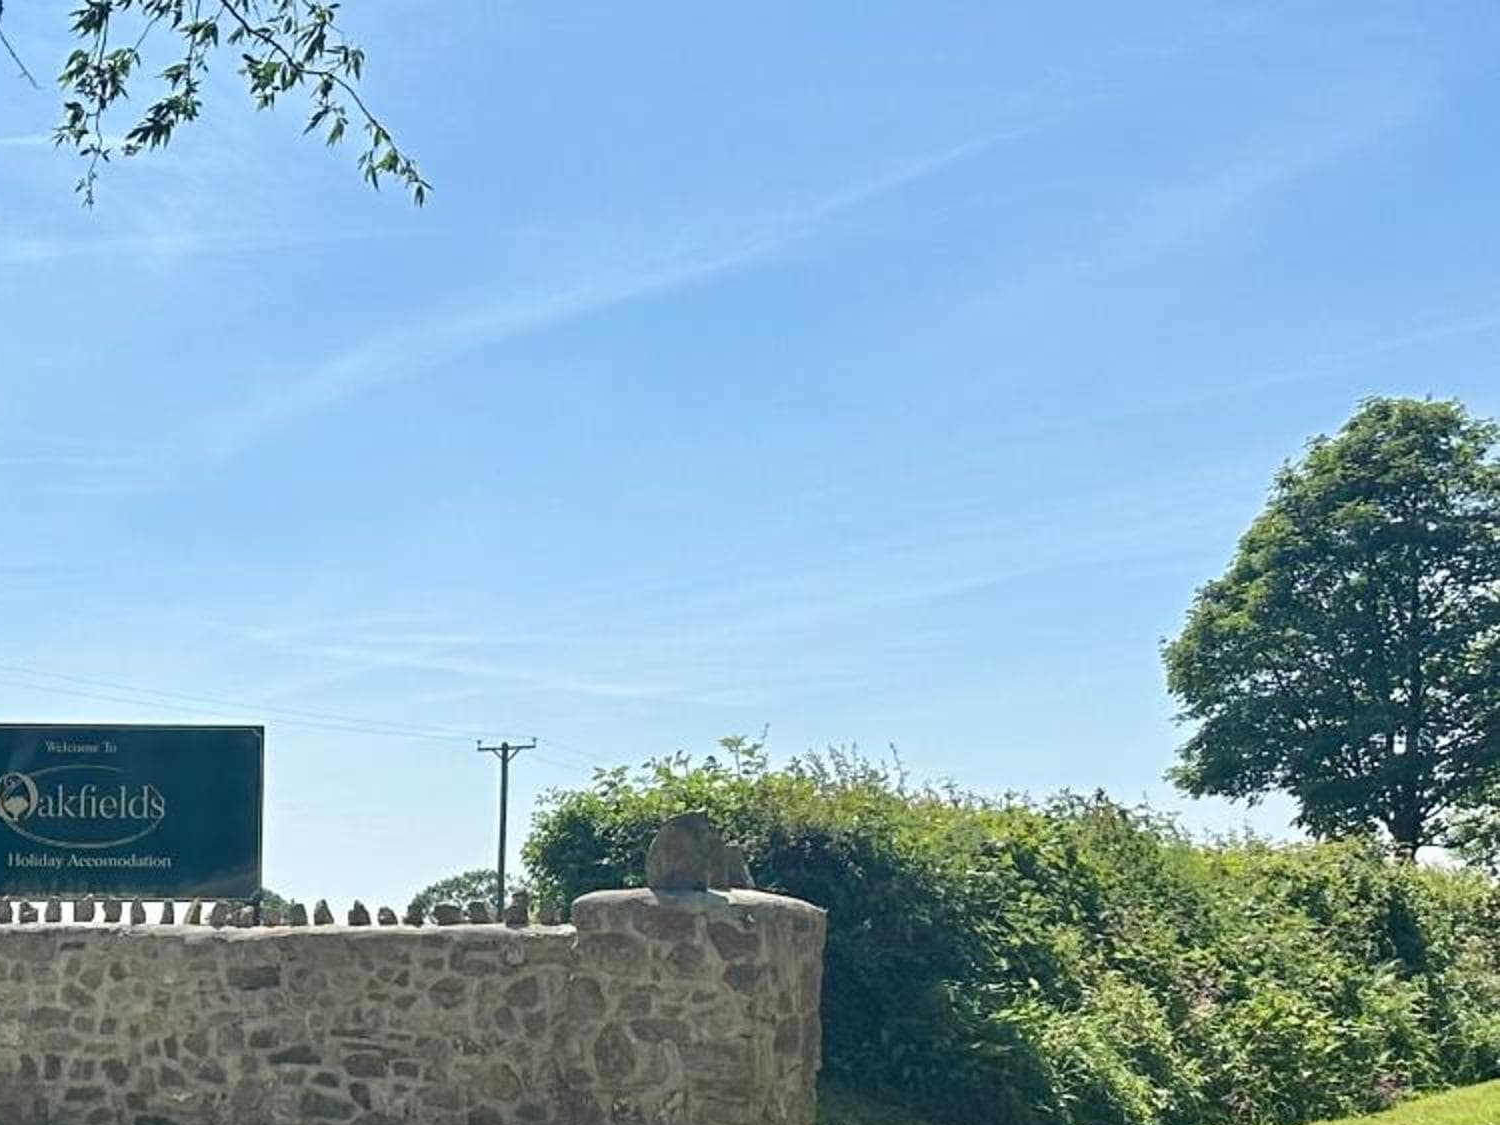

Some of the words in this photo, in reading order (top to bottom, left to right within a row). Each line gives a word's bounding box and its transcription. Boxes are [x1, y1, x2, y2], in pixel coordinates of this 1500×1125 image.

[45, 741, 99, 753] Welcome
[104, 741, 117, 753] To
[8, 853, 63, 868] Holiday
[67, 854, 171, 867] Accomodation
